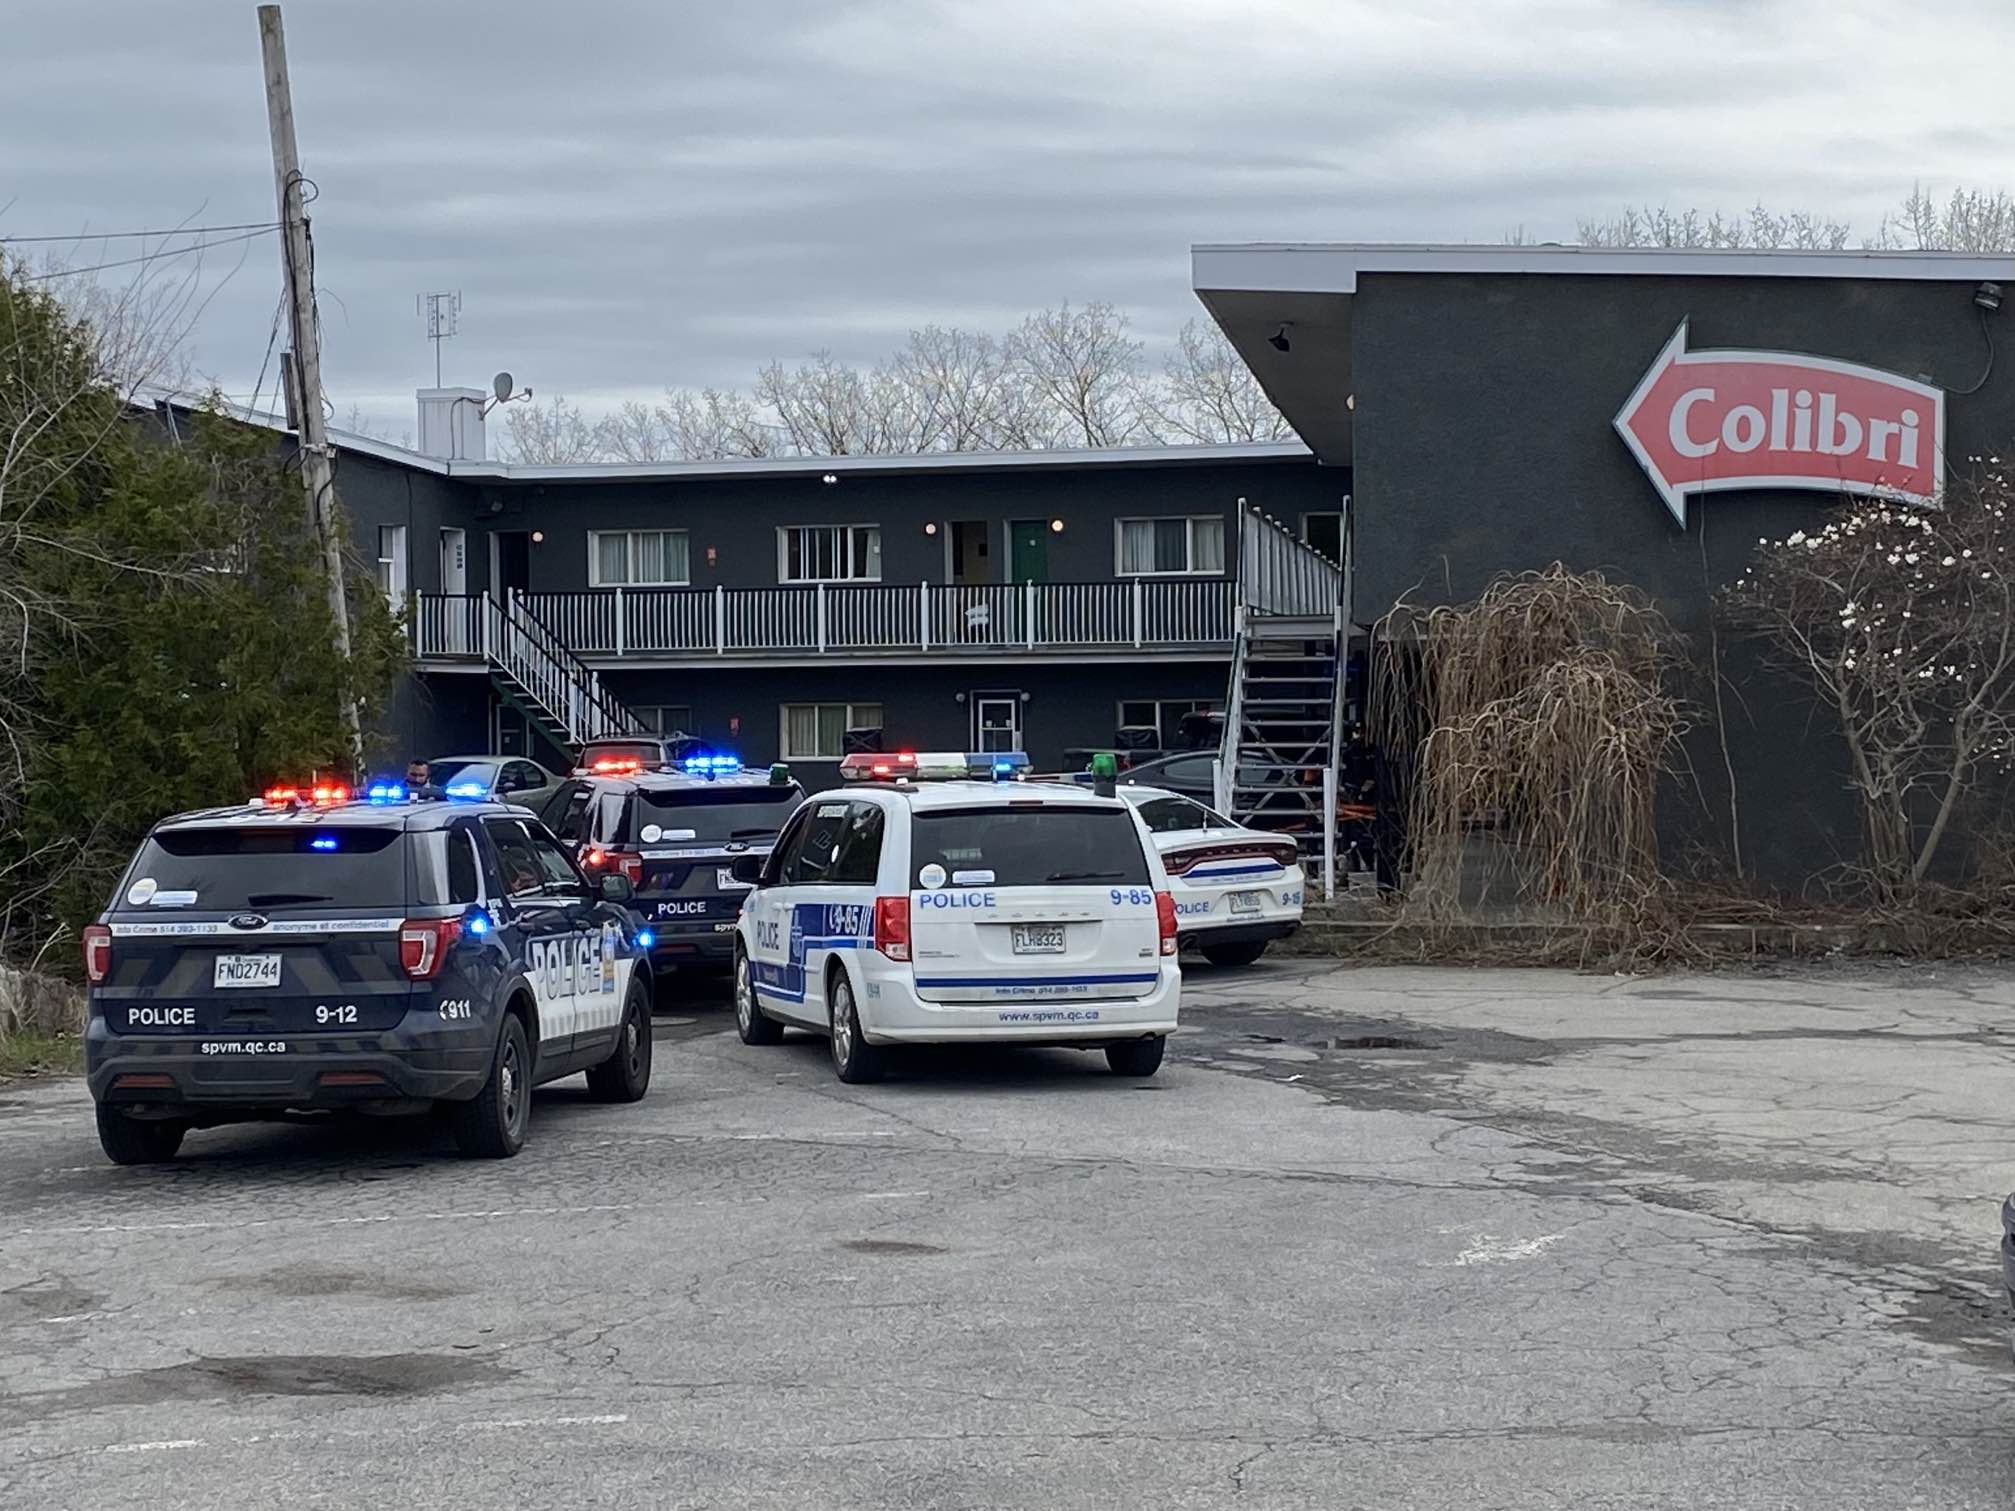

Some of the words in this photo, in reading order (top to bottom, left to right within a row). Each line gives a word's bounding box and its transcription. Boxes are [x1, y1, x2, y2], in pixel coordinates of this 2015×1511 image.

[1668, 387, 1920, 469] Colibri
[920, 892, 996, 909] POLICE
[1111, 889, 1152, 905] 9-85
[658, 902, 707, 914] POLICE
[1174, 901, 1209, 914] OLICE
[834, 905, 859, 934] 9-85
[757, 920, 779, 950] POLICE
[532, 937, 601, 1000] POLICE
[128, 1008, 195, 1024] POLICE
[315, 1006, 357, 1023] 9-12
[448, 1000, 471, 1018] 911
[998, 1011, 1100, 1022] www.spvm.qc.ca
[201, 1041, 286, 1055] spvm.qc.ca
